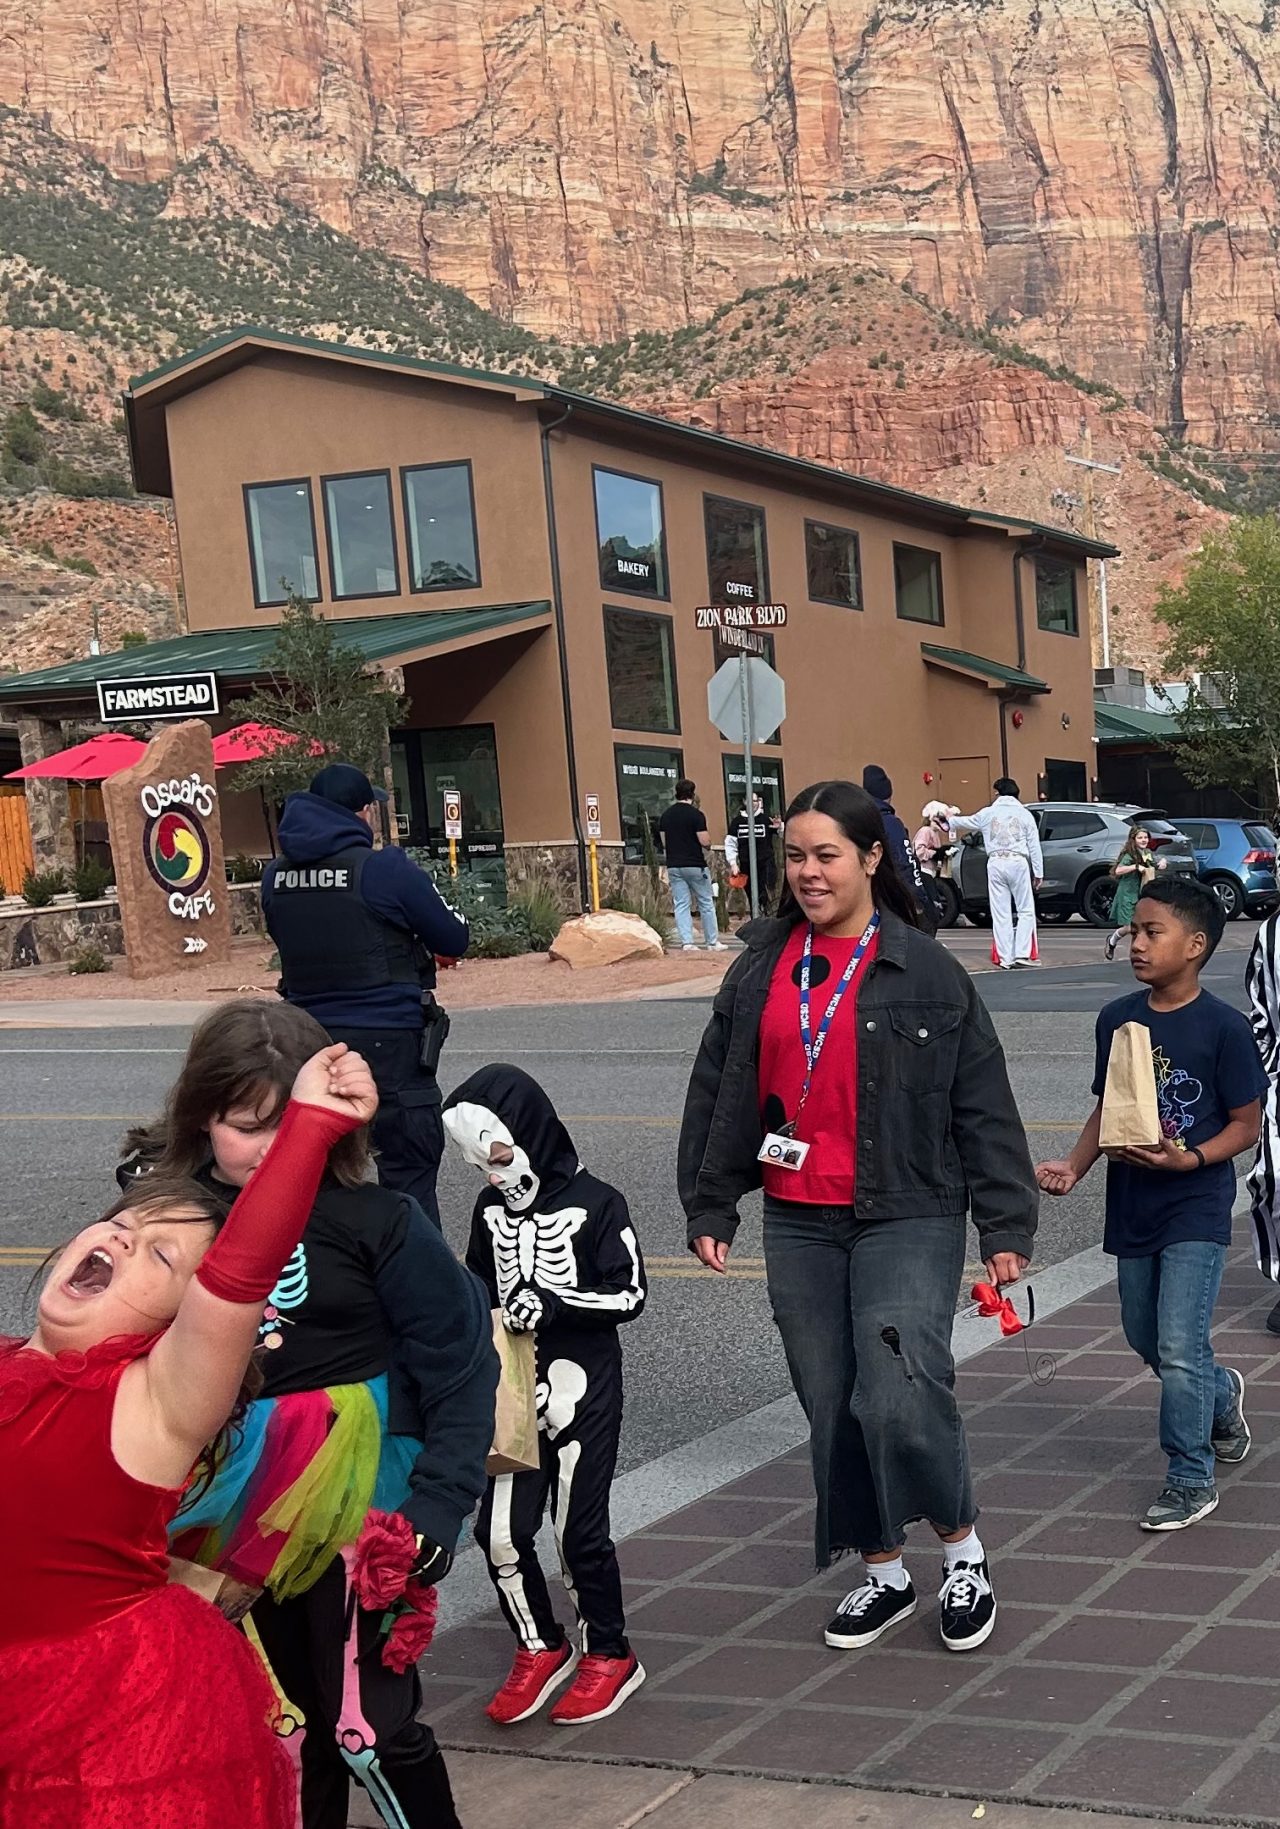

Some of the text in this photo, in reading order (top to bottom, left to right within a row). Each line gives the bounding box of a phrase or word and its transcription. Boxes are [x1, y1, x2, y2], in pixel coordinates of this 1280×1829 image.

[617, 559, 650, 577] BAKERY
[726, 581, 754, 598] COFFEE
[697, 605, 787, 627] ZION PARK BLVD
[104, 683, 211, 711] FARMSTEAD
[903, 839, 923, 887] POLICE
[273, 868, 348, 889] POLICE
[859, 924, 876, 947] WCSD
[801, 966, 810, 991] WCSD
[842, 957, 861, 982] WCSD
[800, 1003, 810, 1030] WCSD
[825, 993, 843, 1018] WCSD
[812, 1031, 827, 1059] WCSD
